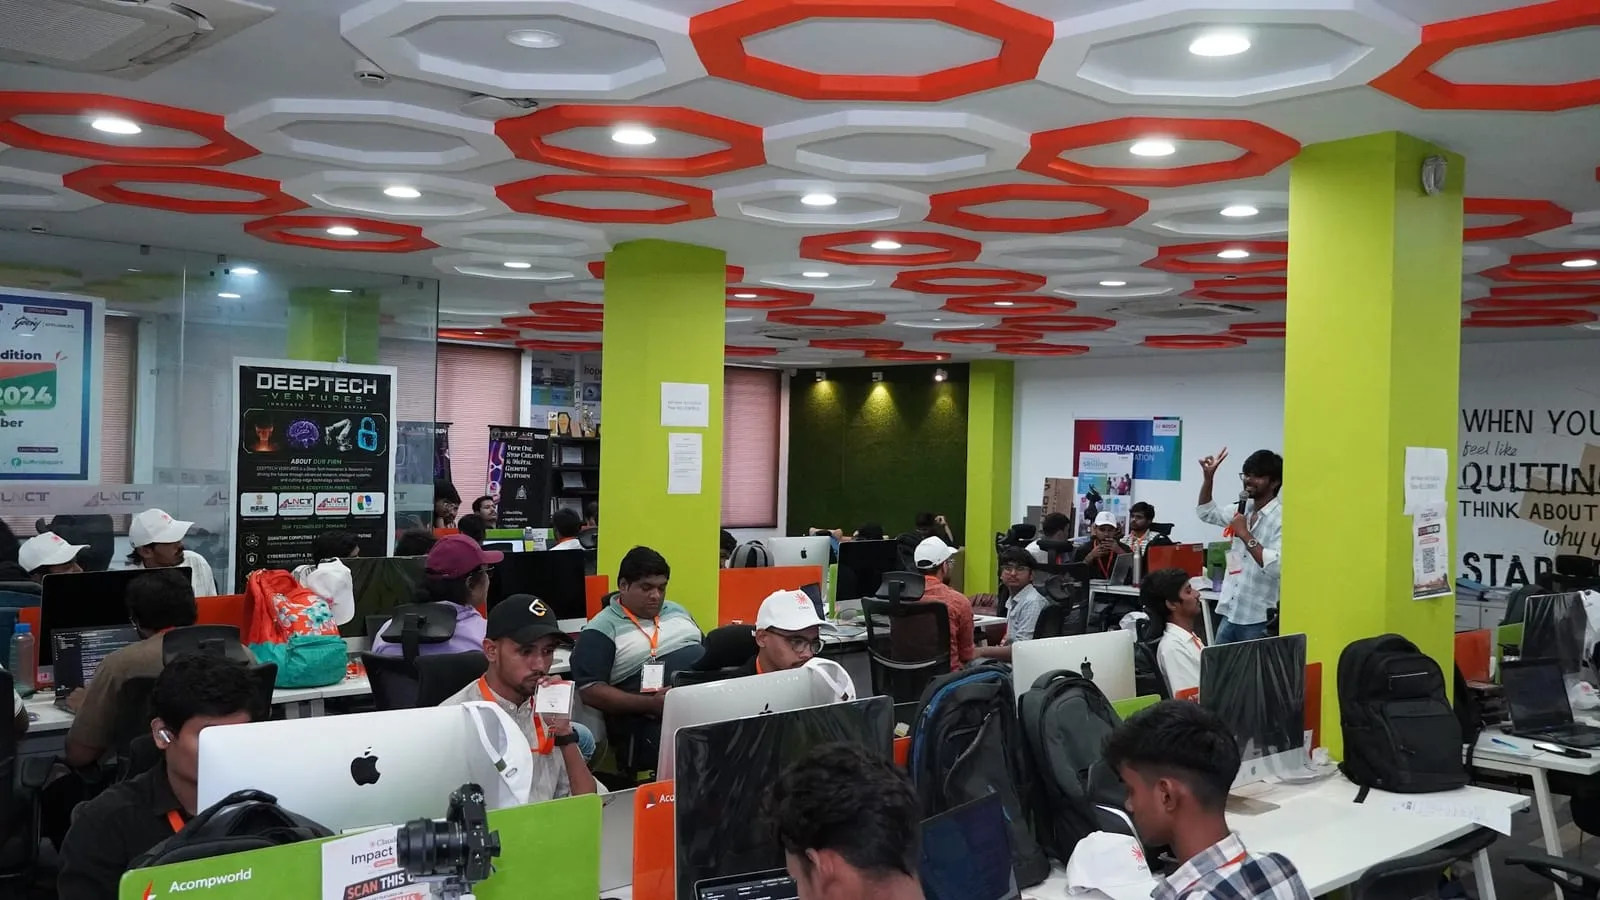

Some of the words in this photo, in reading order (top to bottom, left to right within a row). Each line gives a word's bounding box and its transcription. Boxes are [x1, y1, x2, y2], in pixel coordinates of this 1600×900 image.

[583, 365, 602, 380] hop
[256, 373, 377, 394] DEEPTECH
[0, 386, 53, 405] 024
[271, 392, 362, 403] VENTURES
[1462, 409, 1533, 434] WHEN
[1547, 410, 1600, 436] YOU
[1089, 444, 1164, 452] INDUSTRY-ACADEMIA
[1462, 441, 1489, 457] feel
[1494, 440, 1518, 457] like
[1462, 462, 1600, 496] QUITTIN
[1459, 500, 1520, 519] THINK
[1529, 503, 1598, 521] ABOUT
[1543, 524, 1586, 554] why
[351, 846, 393, 865] Impact
[169, 868, 252, 893] Acompworld
[347, 880, 378, 899] SCAN
[380, 873, 405, 889] THIS
